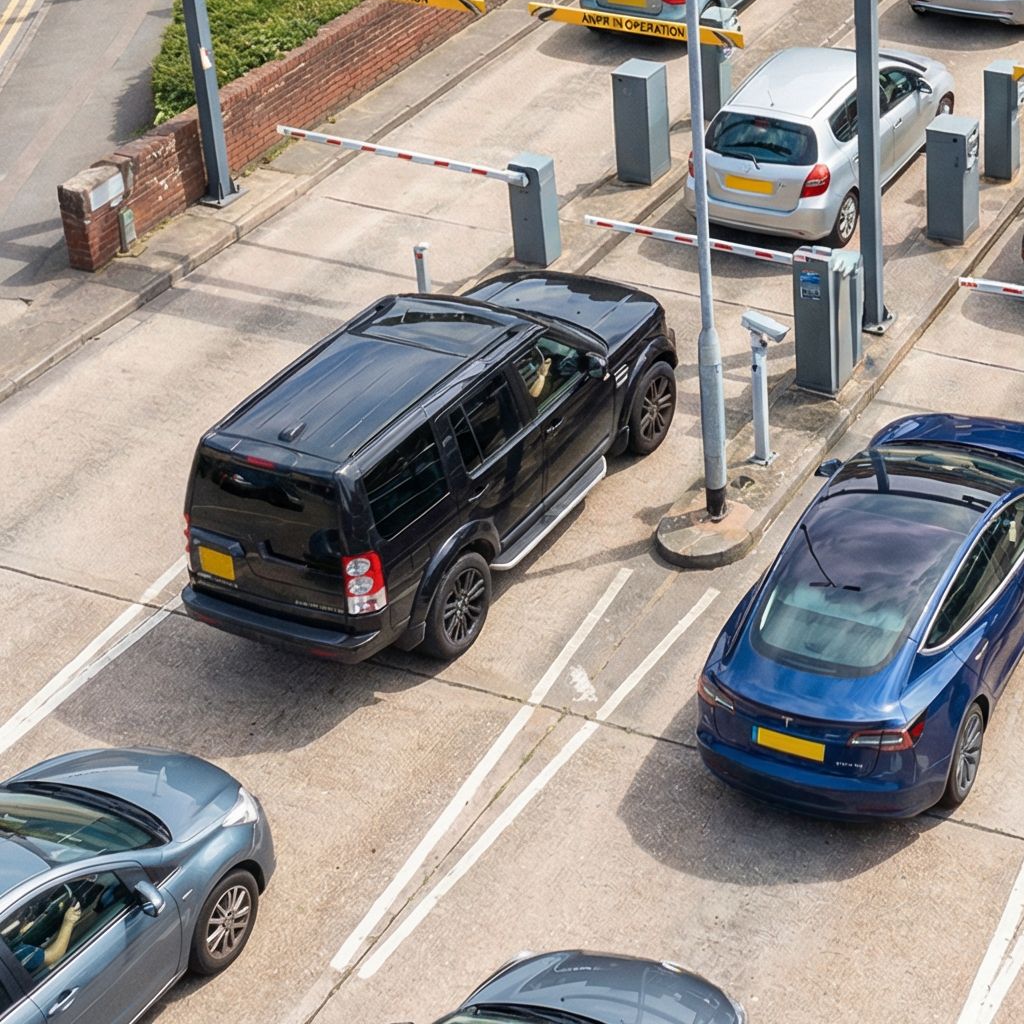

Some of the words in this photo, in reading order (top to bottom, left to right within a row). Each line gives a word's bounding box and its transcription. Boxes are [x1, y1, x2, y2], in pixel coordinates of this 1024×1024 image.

[582, 12, 610, 26] ANPR
[613, 17, 624, 29] IN
[624, 19, 686, 38] OPERATION
